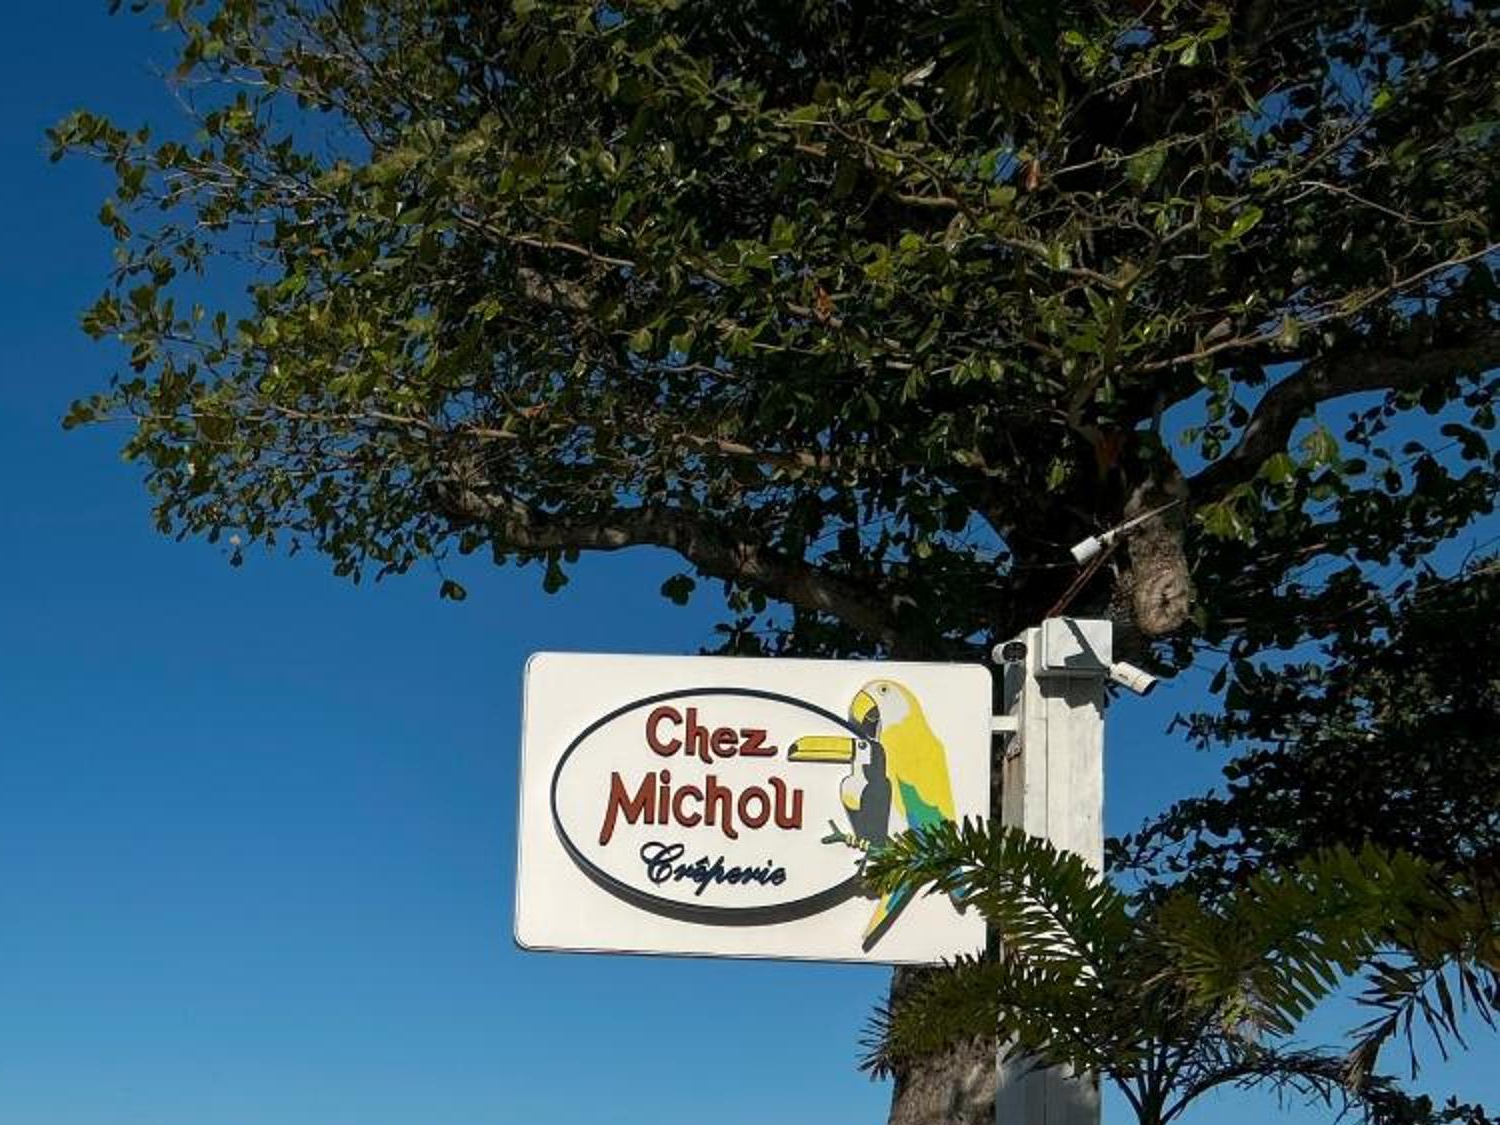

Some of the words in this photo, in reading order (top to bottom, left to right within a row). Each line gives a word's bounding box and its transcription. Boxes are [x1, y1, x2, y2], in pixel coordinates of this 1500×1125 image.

[645, 705, 778, 764] Chez
[599, 769, 804, 847] Michou
[640, 841, 787, 896] Crêperie
